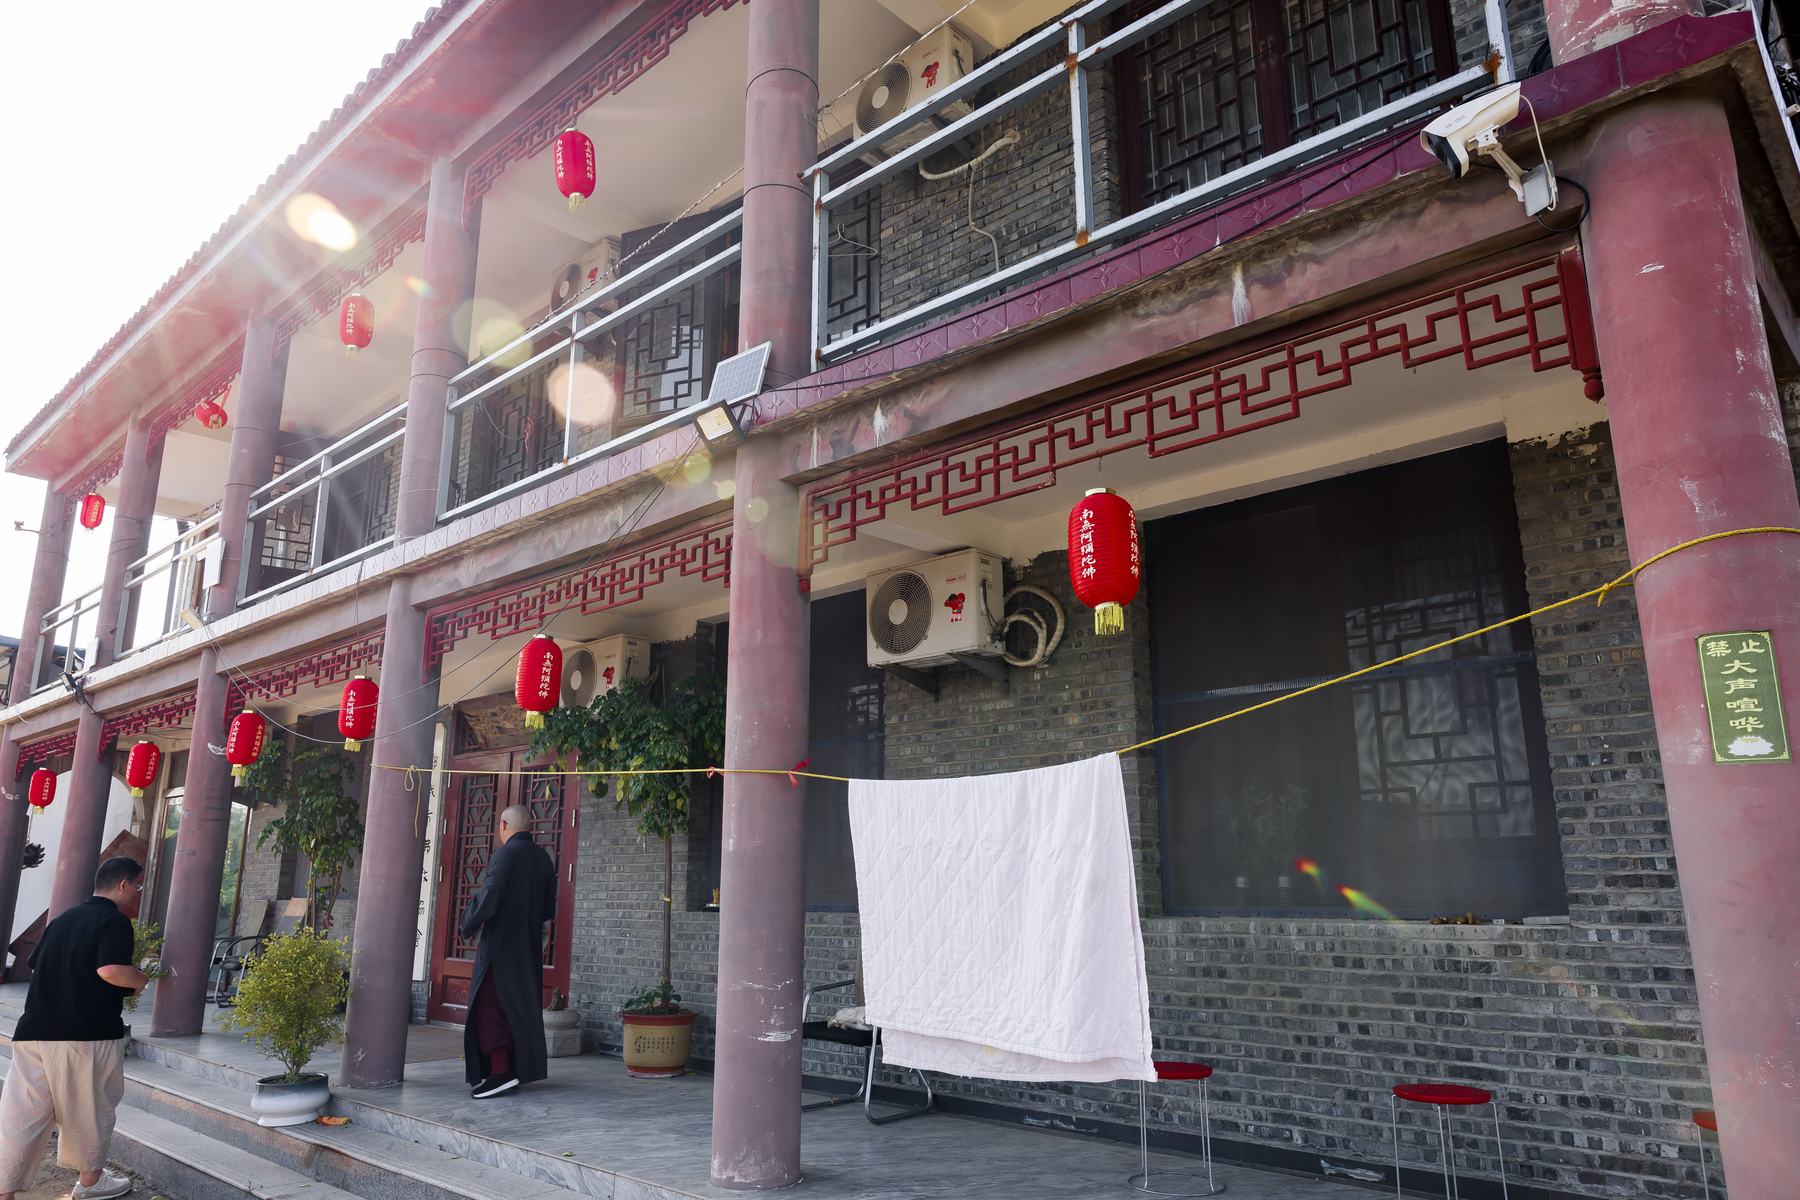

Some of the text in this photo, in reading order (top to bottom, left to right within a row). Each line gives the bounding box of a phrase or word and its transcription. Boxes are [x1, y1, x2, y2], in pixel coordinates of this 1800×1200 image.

[1080, 508, 1096, 580] 南無阿彌陀佛
[1706, 639, 1766, 658] 禁止
[1720, 659, 1765, 733] 大声喧哗
